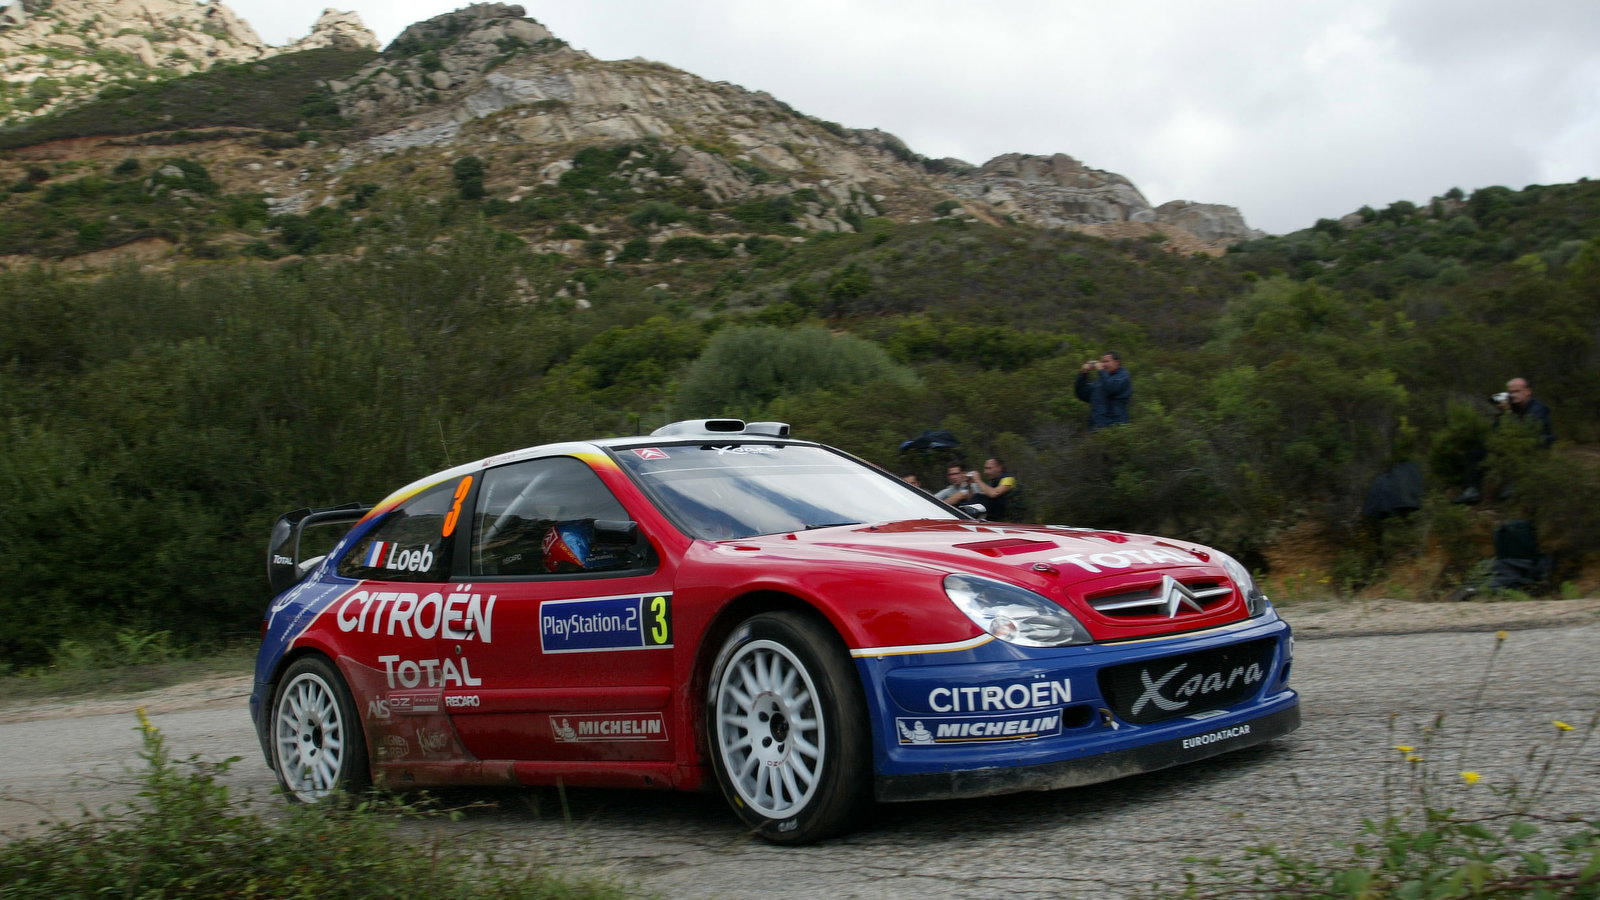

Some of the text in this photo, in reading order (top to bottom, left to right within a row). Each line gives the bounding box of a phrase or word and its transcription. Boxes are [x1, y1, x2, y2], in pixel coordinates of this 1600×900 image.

[442, 475, 473, 537] 3
[273, 554, 293, 565] TOTAL
[386, 542, 433, 572] Loeb
[1048, 549, 1200, 573] TOTAL
[337, 584, 497, 643] CITROËN
[651, 596, 668, 644] 3
[378, 655, 482, 689] TOTAL
[445, 695, 480, 707] RECARO
[928, 674, 1072, 713] CITROËN
[1130, 662, 1263, 716] Xsara
[578, 719, 661, 735] MICHELIN
[936, 715, 1059, 738] MICHELIN
[1182, 724, 1251, 749] EURODATACAR
